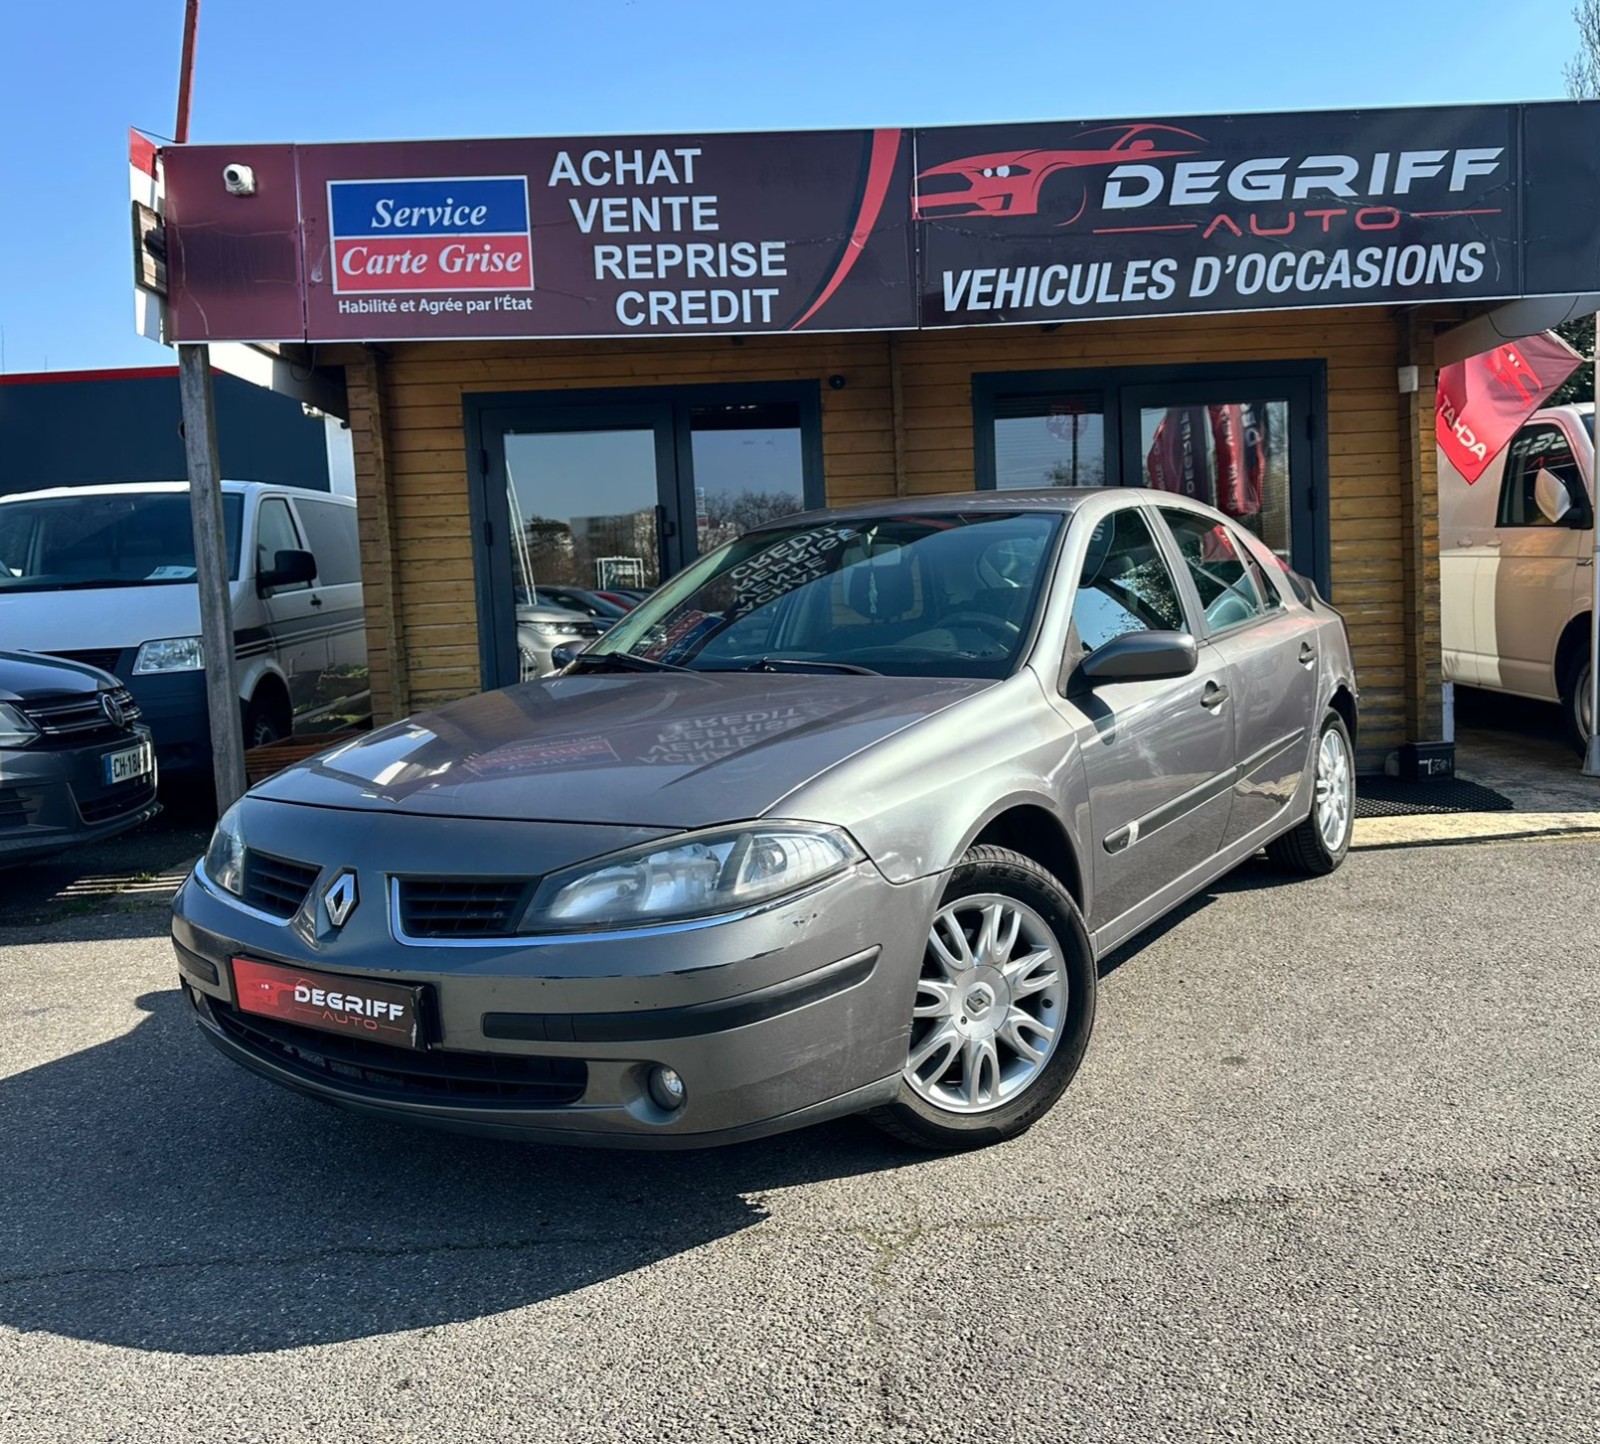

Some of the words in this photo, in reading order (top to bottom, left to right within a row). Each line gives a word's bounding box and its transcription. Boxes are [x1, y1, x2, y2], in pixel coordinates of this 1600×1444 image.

[549, 148, 702, 187] ACHAT
[1102, 147, 1504, 210] DEGRIFF
[371, 198, 487, 228] Service
[569, 195, 719, 233] VENTE
[1202, 207, 1400, 239] AUTO
[342, 247, 428, 275] Carte
[438, 244, 522, 273] Grise
[595, 242, 788, 280] REPRISE
[943, 258, 1177, 312] VEHICULES
[1190, 241, 1486, 297] D'OCCASIONS
[338, 299, 397, 314] Habilité
[400, 302, 416, 313] et
[418, 298, 463, 315] Agrée
[466, 302, 491, 314] par
[494, 294, 533, 311] l'État
[616, 288, 779, 326] CREDIT
[294, 985, 405, 1021] DEGRIFF
[322, 1011, 378, 1030] AUTO
